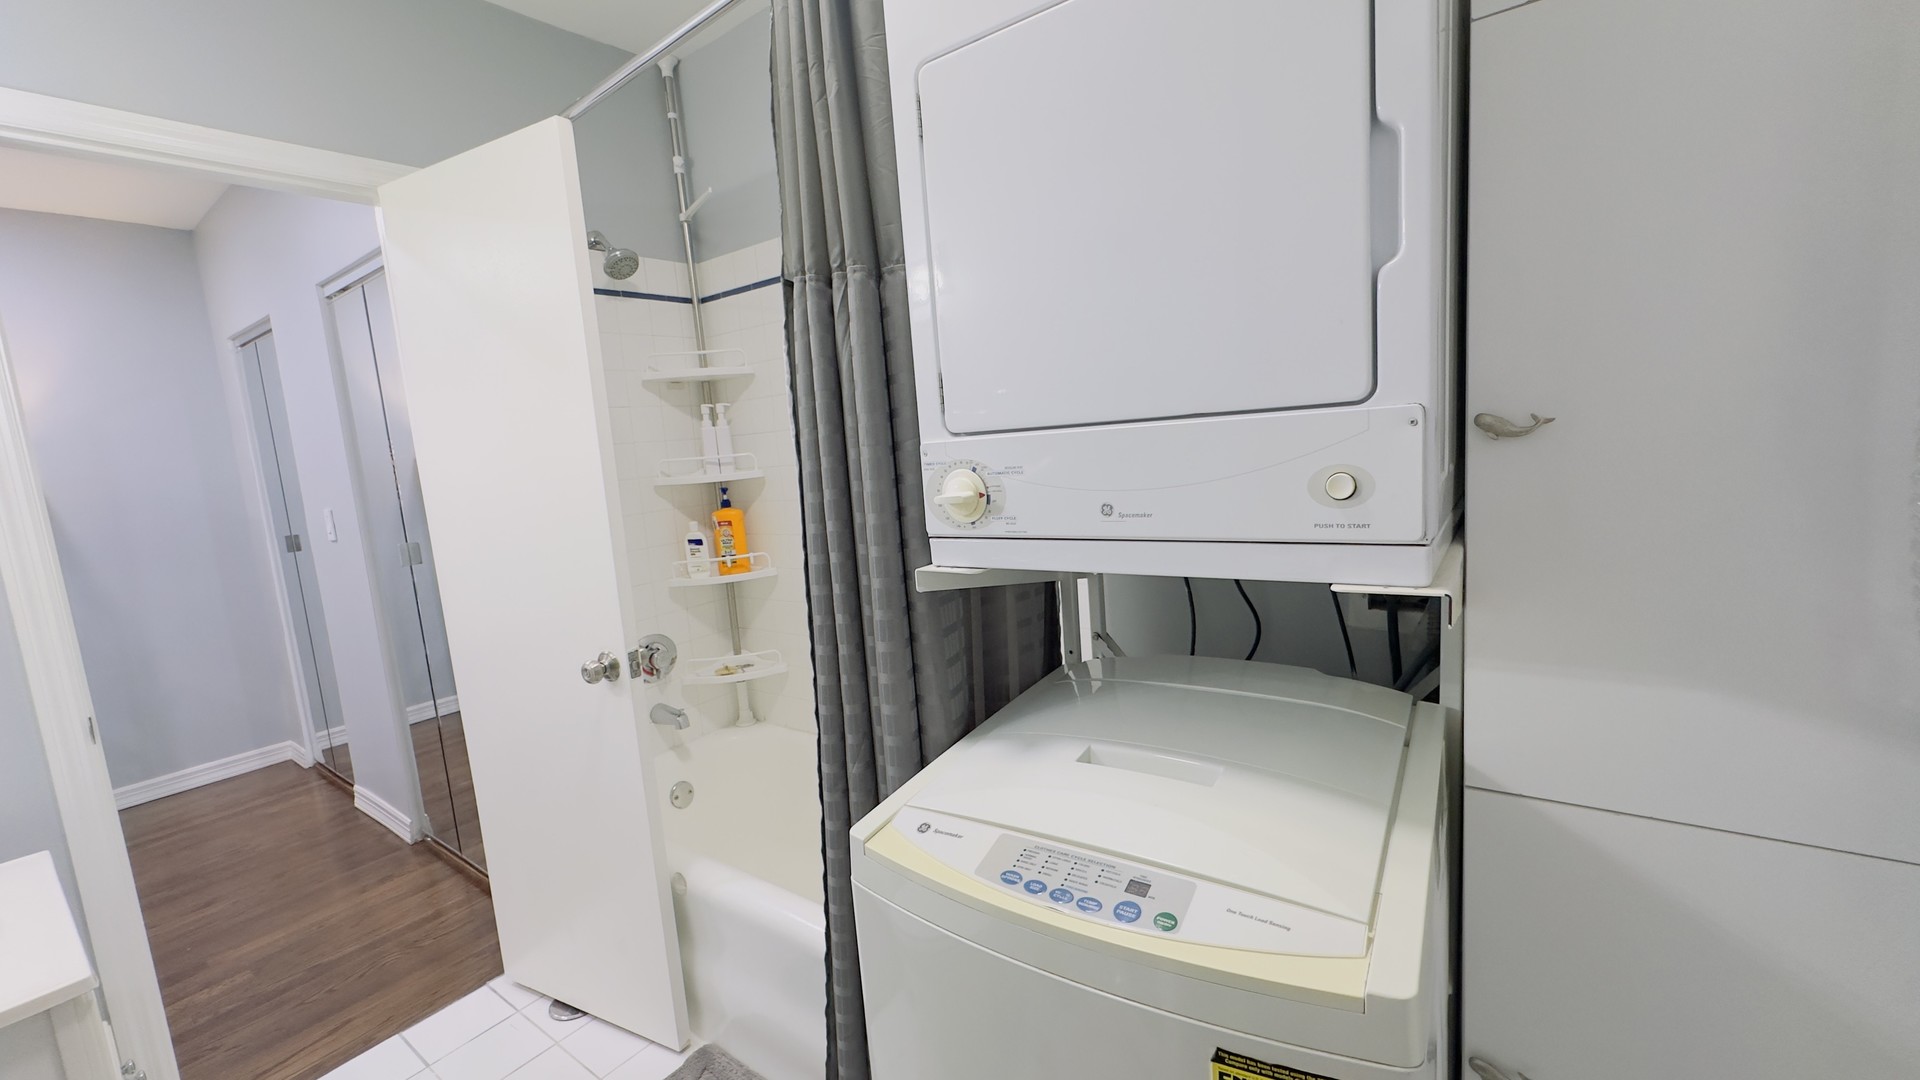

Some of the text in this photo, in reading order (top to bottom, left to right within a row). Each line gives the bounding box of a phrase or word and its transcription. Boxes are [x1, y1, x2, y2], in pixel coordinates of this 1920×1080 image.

[1118, 511, 1153, 519] Spacemaker
[1115, 909, 1136, 919] PAUSE
[1118, 905, 1138, 913] START
[1238, 911, 1254, 919] Touch
[1254, 916, 1268, 924] Load
[1269, 920, 1291, 931] Sensing
[1217, 1051, 1229, 1059] This
[1230, 1055, 1246, 1063] model
[1257, 1062, 1271, 1070] been
[1271, 1066, 1289, 1075] tested
[1224, 1058, 1248, 1069] Compare
[1248, 1066, 1260, 1074] only
